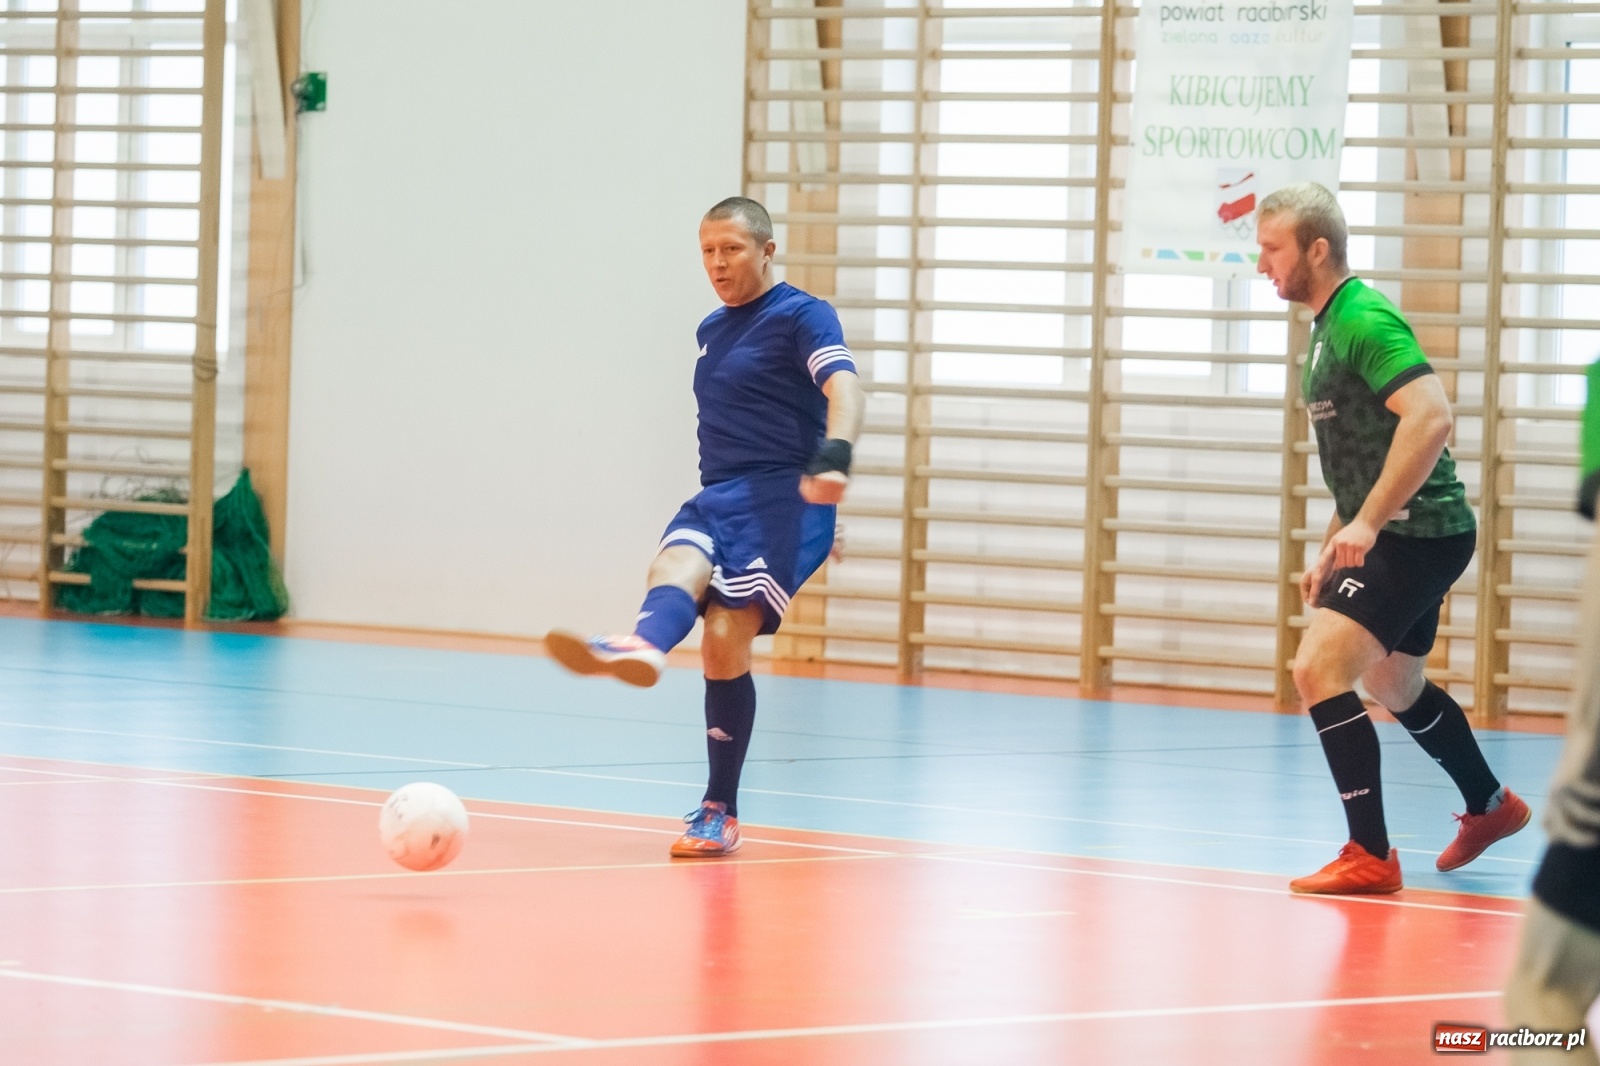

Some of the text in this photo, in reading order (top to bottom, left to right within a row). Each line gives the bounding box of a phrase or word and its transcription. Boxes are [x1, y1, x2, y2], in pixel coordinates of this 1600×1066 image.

[1160, 0, 1224, 27] powiat
[1161, 29, 1218, 43] zielona
[1168, 74, 1315, 115] KIBICUJEMY
[1141, 125, 1337, 160] SPORTOWCOM
